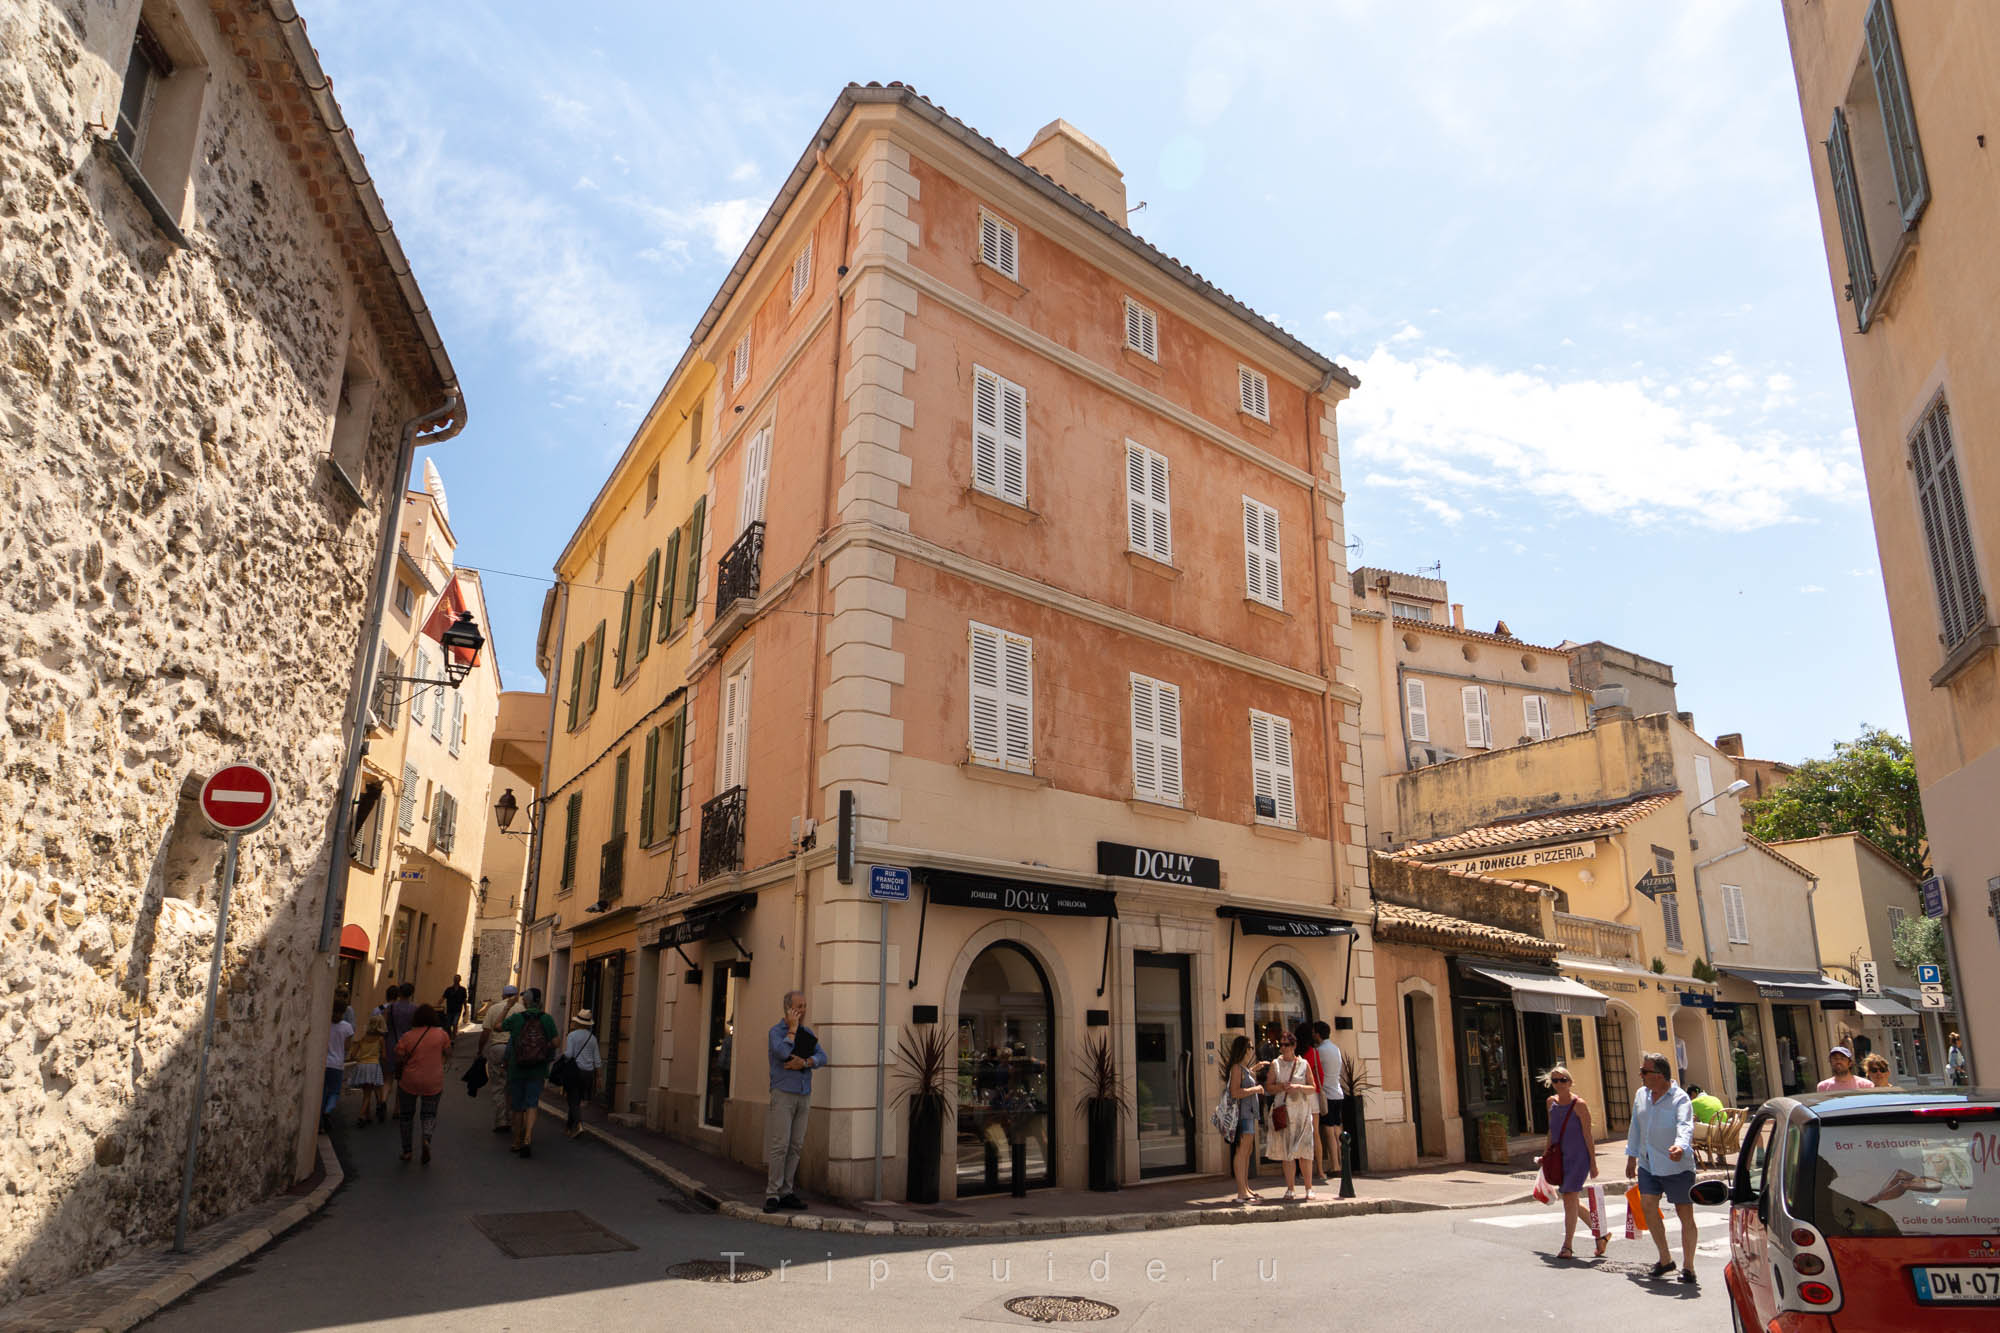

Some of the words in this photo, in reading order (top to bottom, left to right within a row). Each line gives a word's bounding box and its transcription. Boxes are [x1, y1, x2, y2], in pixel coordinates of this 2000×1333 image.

[1134, 848, 1194, 884] DOUX
[1465, 862, 1477, 872] LA
[1480, 855, 1527, 870] TONNELLE
[1534, 846, 1585, 863] PIZZERIA
[1641, 876, 1674, 886] PIZZERIA
[1004, 887, 1049, 911] DOUX
[1923, 967, 1935, 981] P
[1834, 1141, 1854, 1151] Bar
